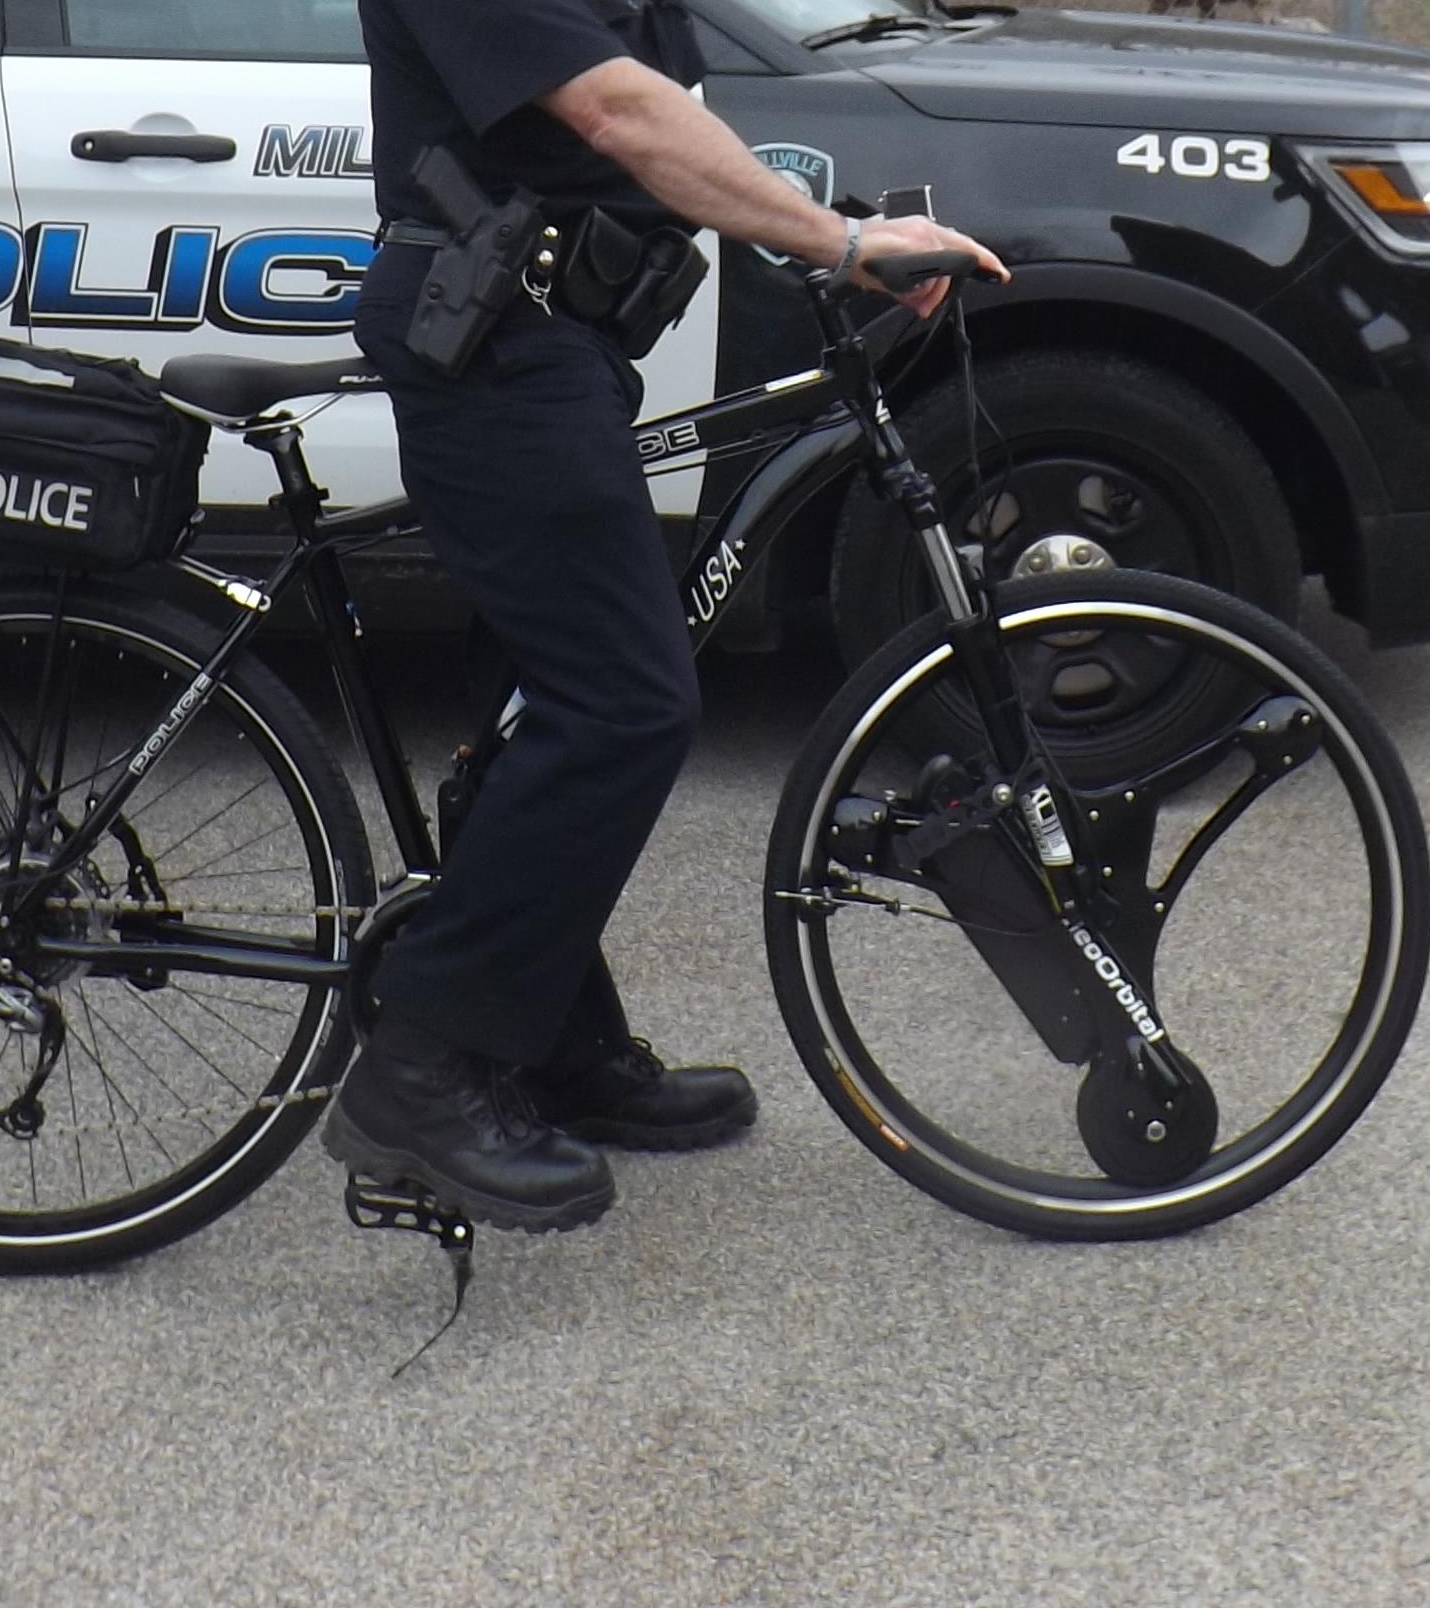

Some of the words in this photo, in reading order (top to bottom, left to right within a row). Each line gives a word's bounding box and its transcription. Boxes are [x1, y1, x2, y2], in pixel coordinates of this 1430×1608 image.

[1116, 133, 1271, 182] 403
[690, 539, 743, 623] USA
[128, 672, 213, 776] POLICE
[1063, 919, 1166, 1044] eoOrbital
